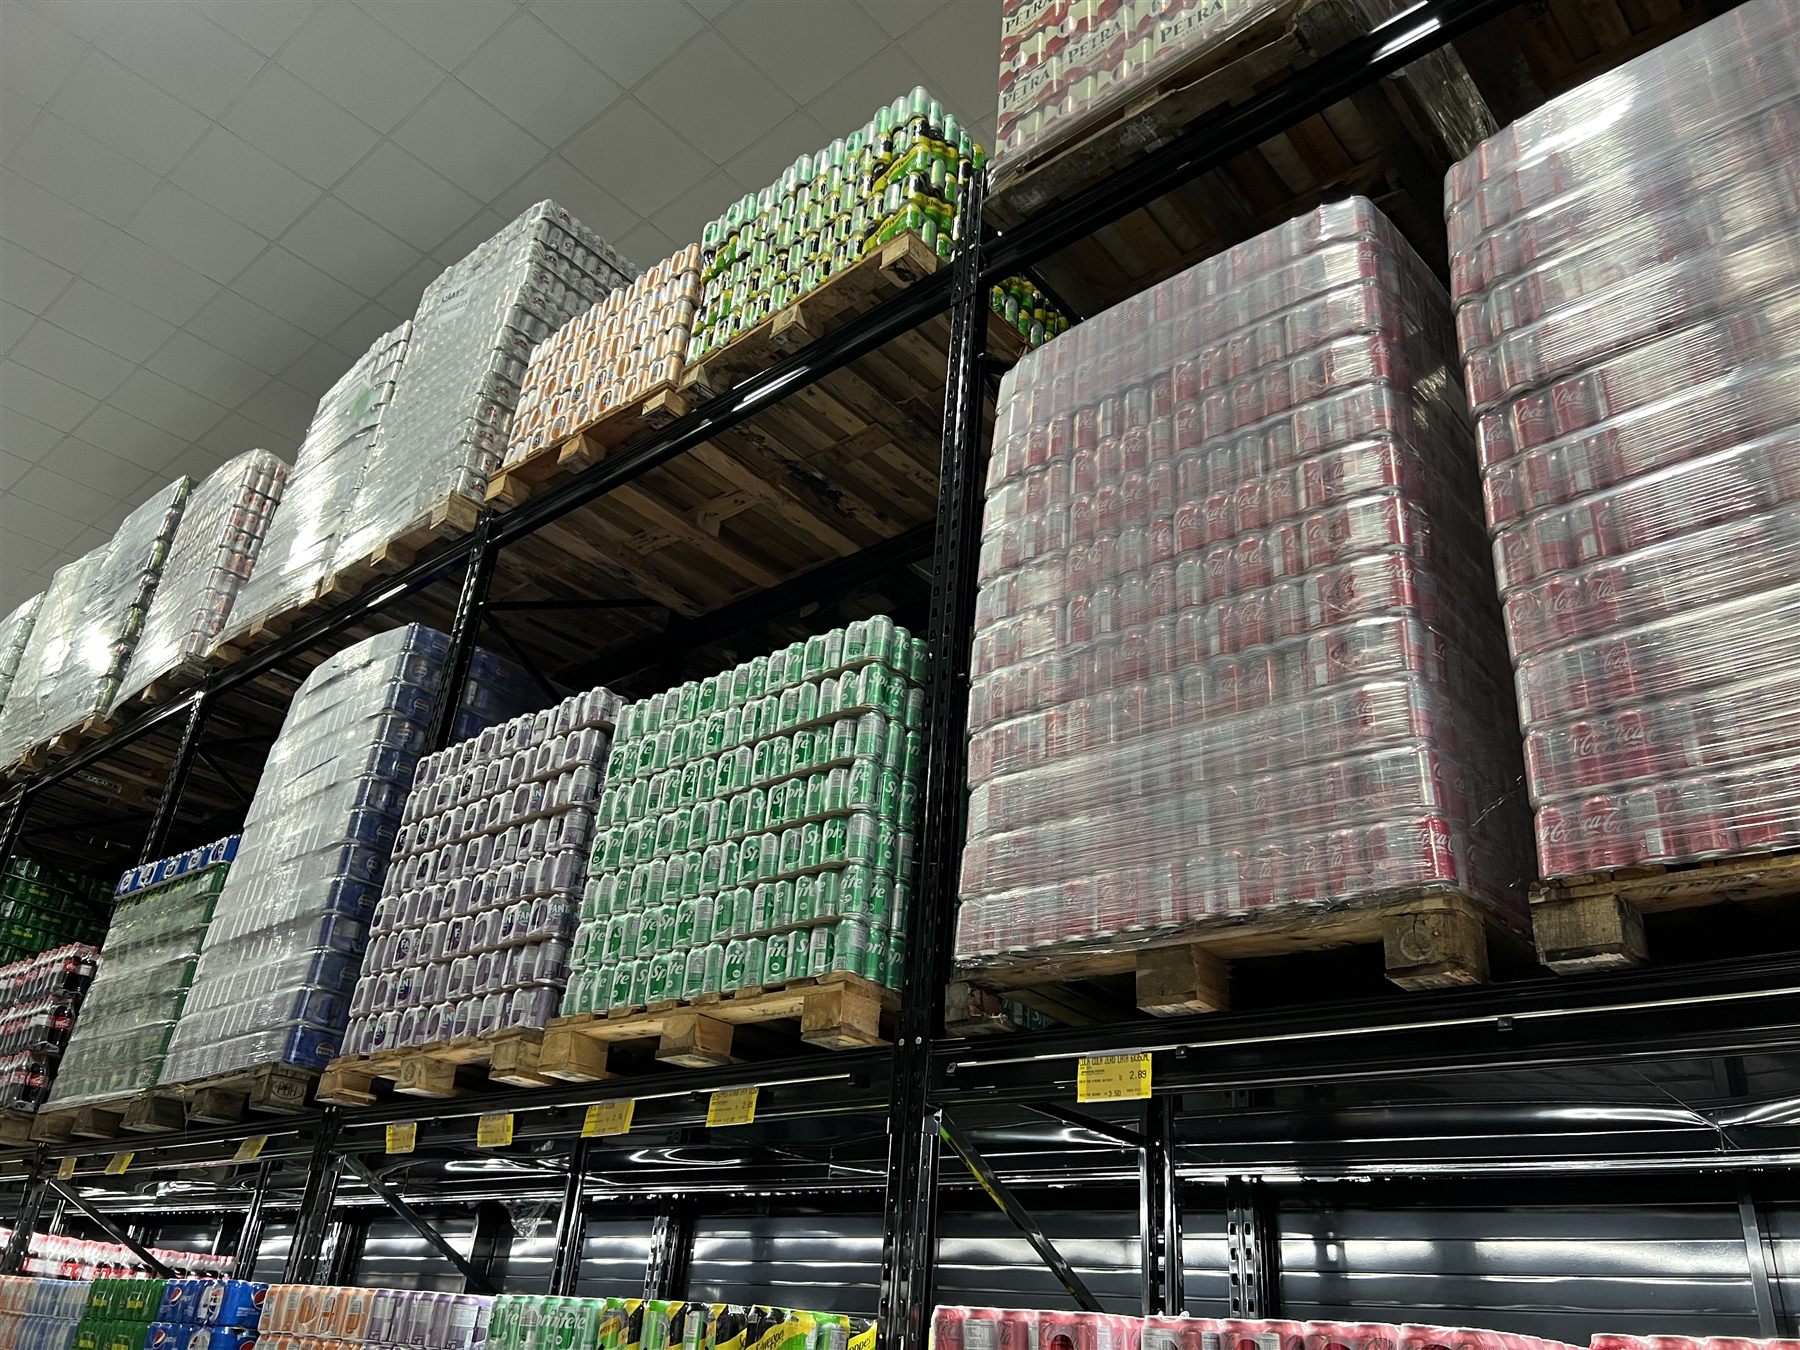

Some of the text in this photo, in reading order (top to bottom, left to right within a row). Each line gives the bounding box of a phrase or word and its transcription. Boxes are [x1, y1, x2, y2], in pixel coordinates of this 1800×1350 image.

[1068, 21, 1122, 64] PETRA
[1161, 0, 1222, 43] PETRA
[1003, 69, 1050, 110] PETRA
